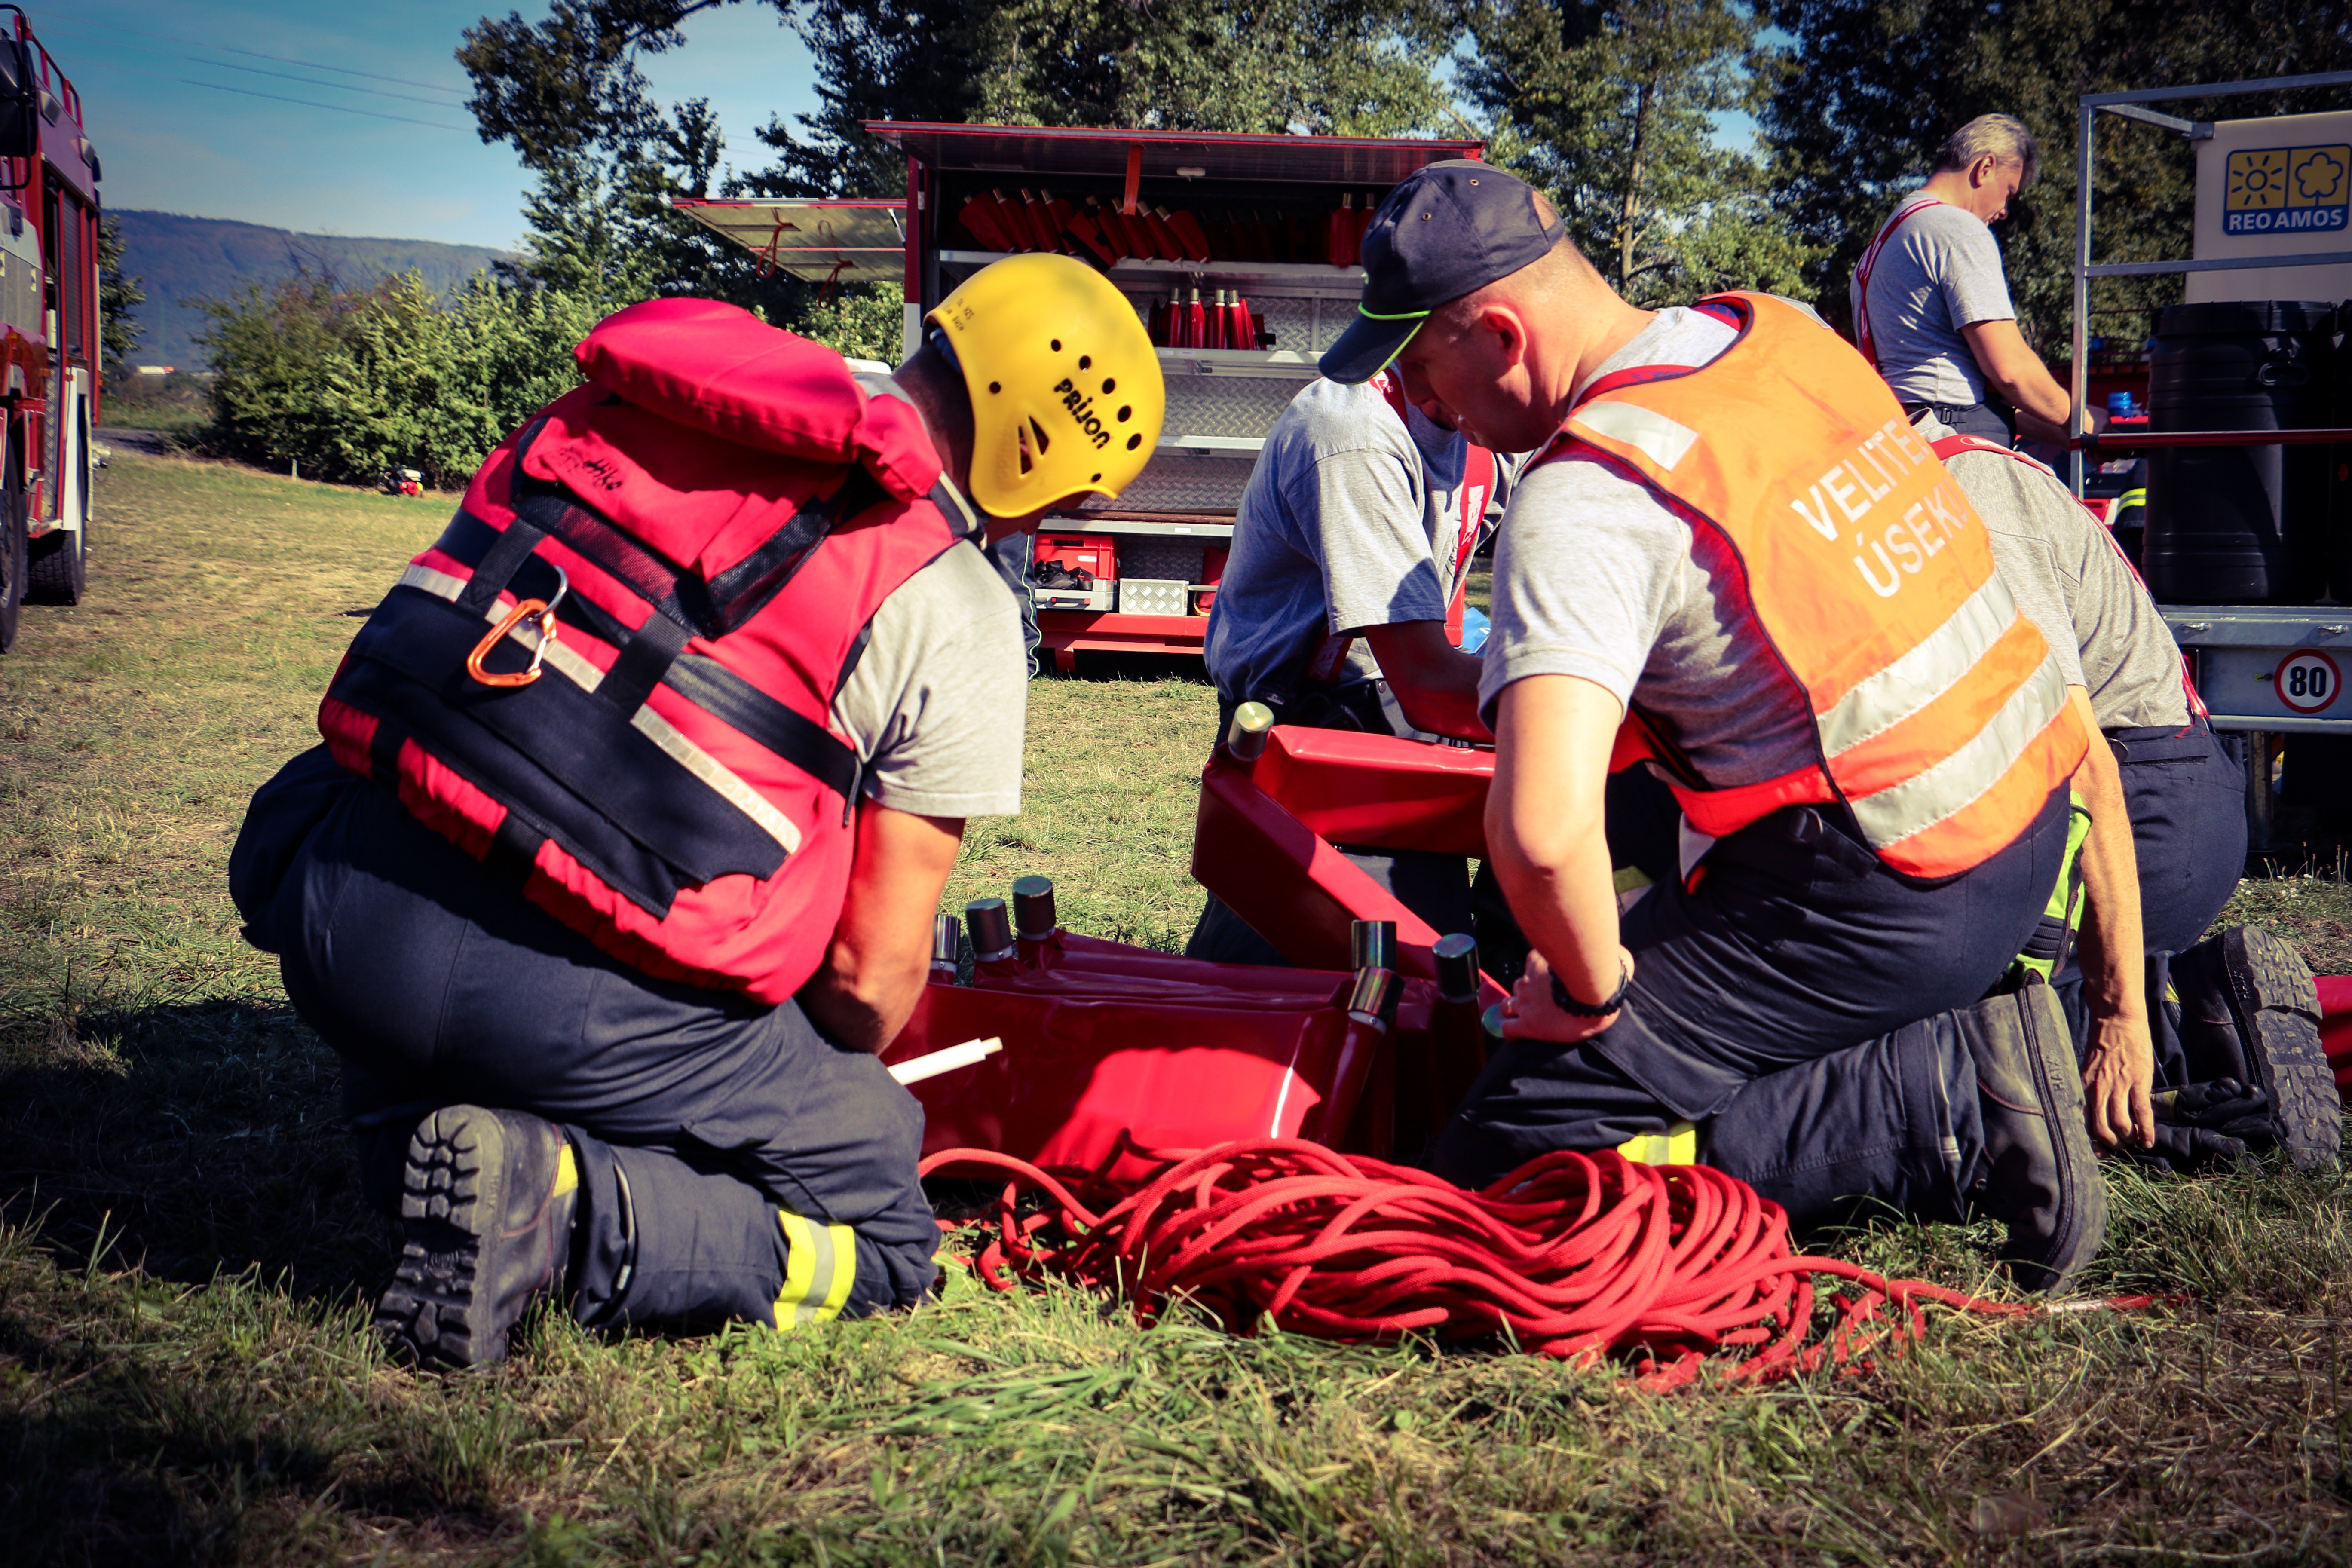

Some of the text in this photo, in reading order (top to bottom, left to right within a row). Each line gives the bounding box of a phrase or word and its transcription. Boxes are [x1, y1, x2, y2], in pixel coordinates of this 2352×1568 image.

[2229, 209, 2343, 230] REO AMOS
[1789, 416, 1931, 542] VELITEL
[1853, 475, 1968, 597] ÚSEKU
[2289, 666, 2327, 698] 80
